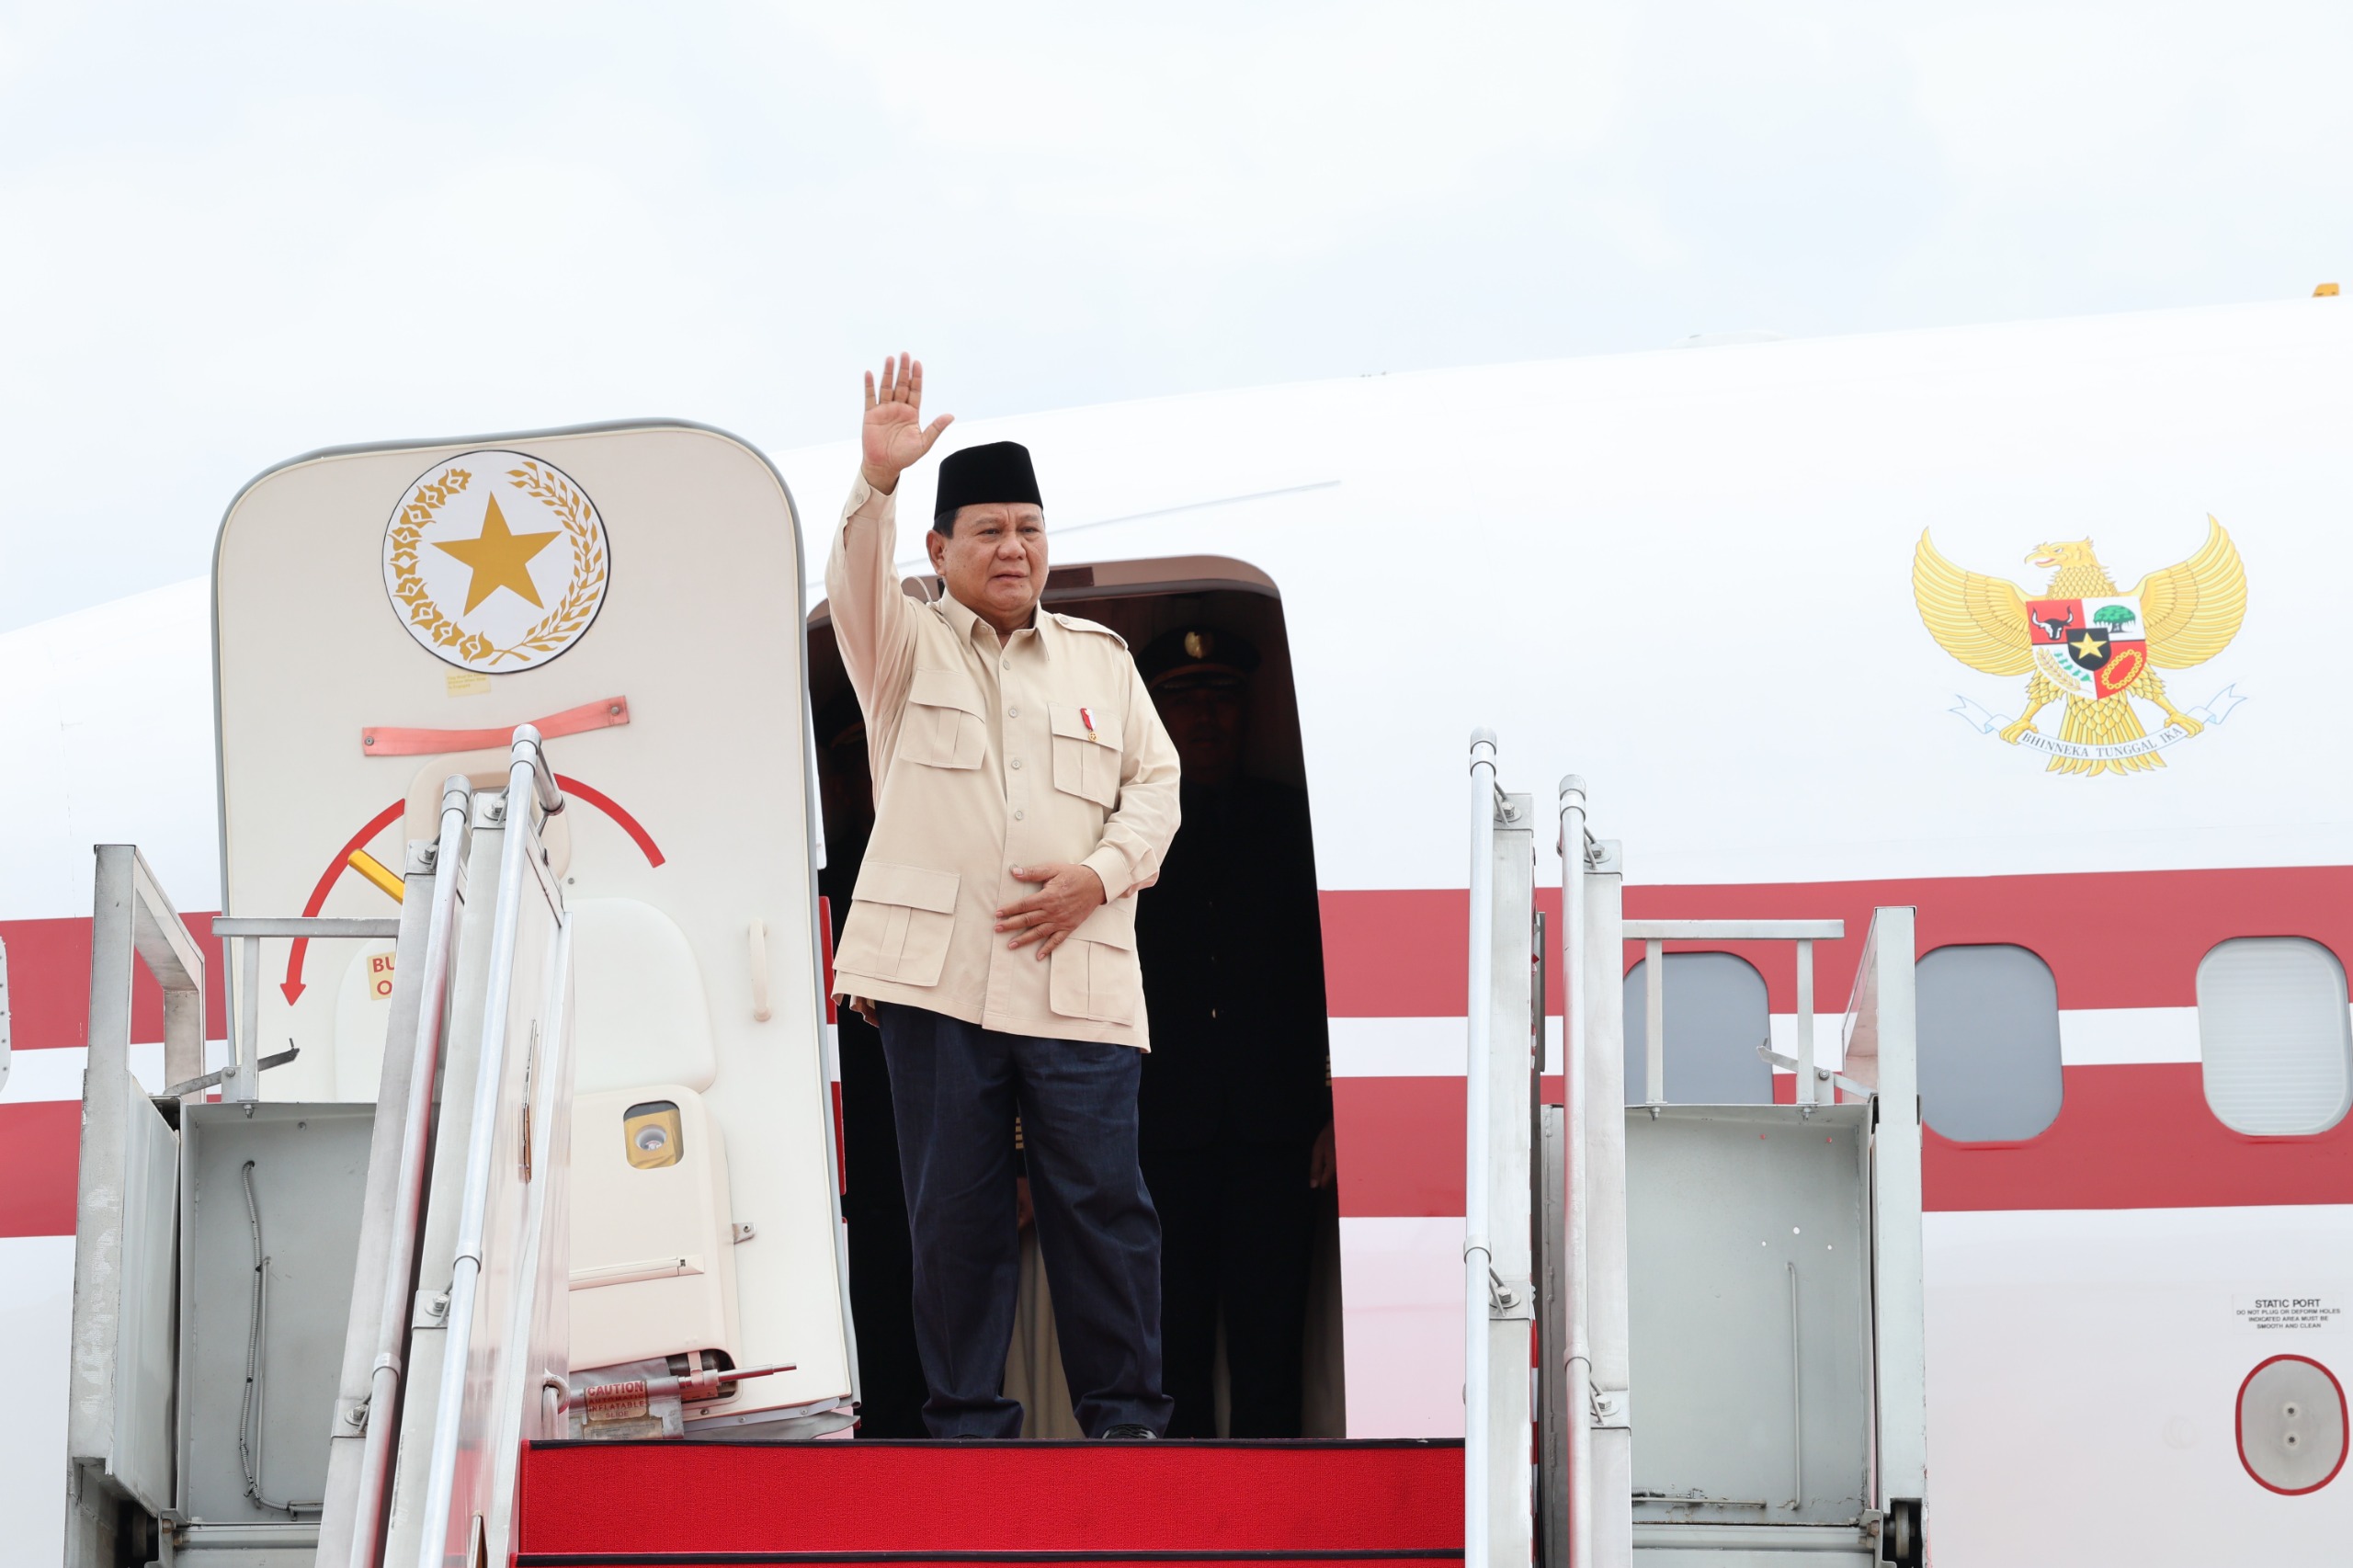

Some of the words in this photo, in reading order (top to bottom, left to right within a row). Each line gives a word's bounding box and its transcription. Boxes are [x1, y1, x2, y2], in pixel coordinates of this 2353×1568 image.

[2022, 733, 2088, 757] BHINNEKA
[2097, 739, 2157, 757] TUNGGAL
[2159, 728, 2183, 744] IKA
[2255, 1299, 2290, 1308] STATIC
[2292, 1299, 2321, 1308] PORT
[587, 1381, 643, 1396] CAUTION
[588, 1394, 643, 1404] AUTOMATIC
[588, 1401, 644, 1413] INFLATABLE
